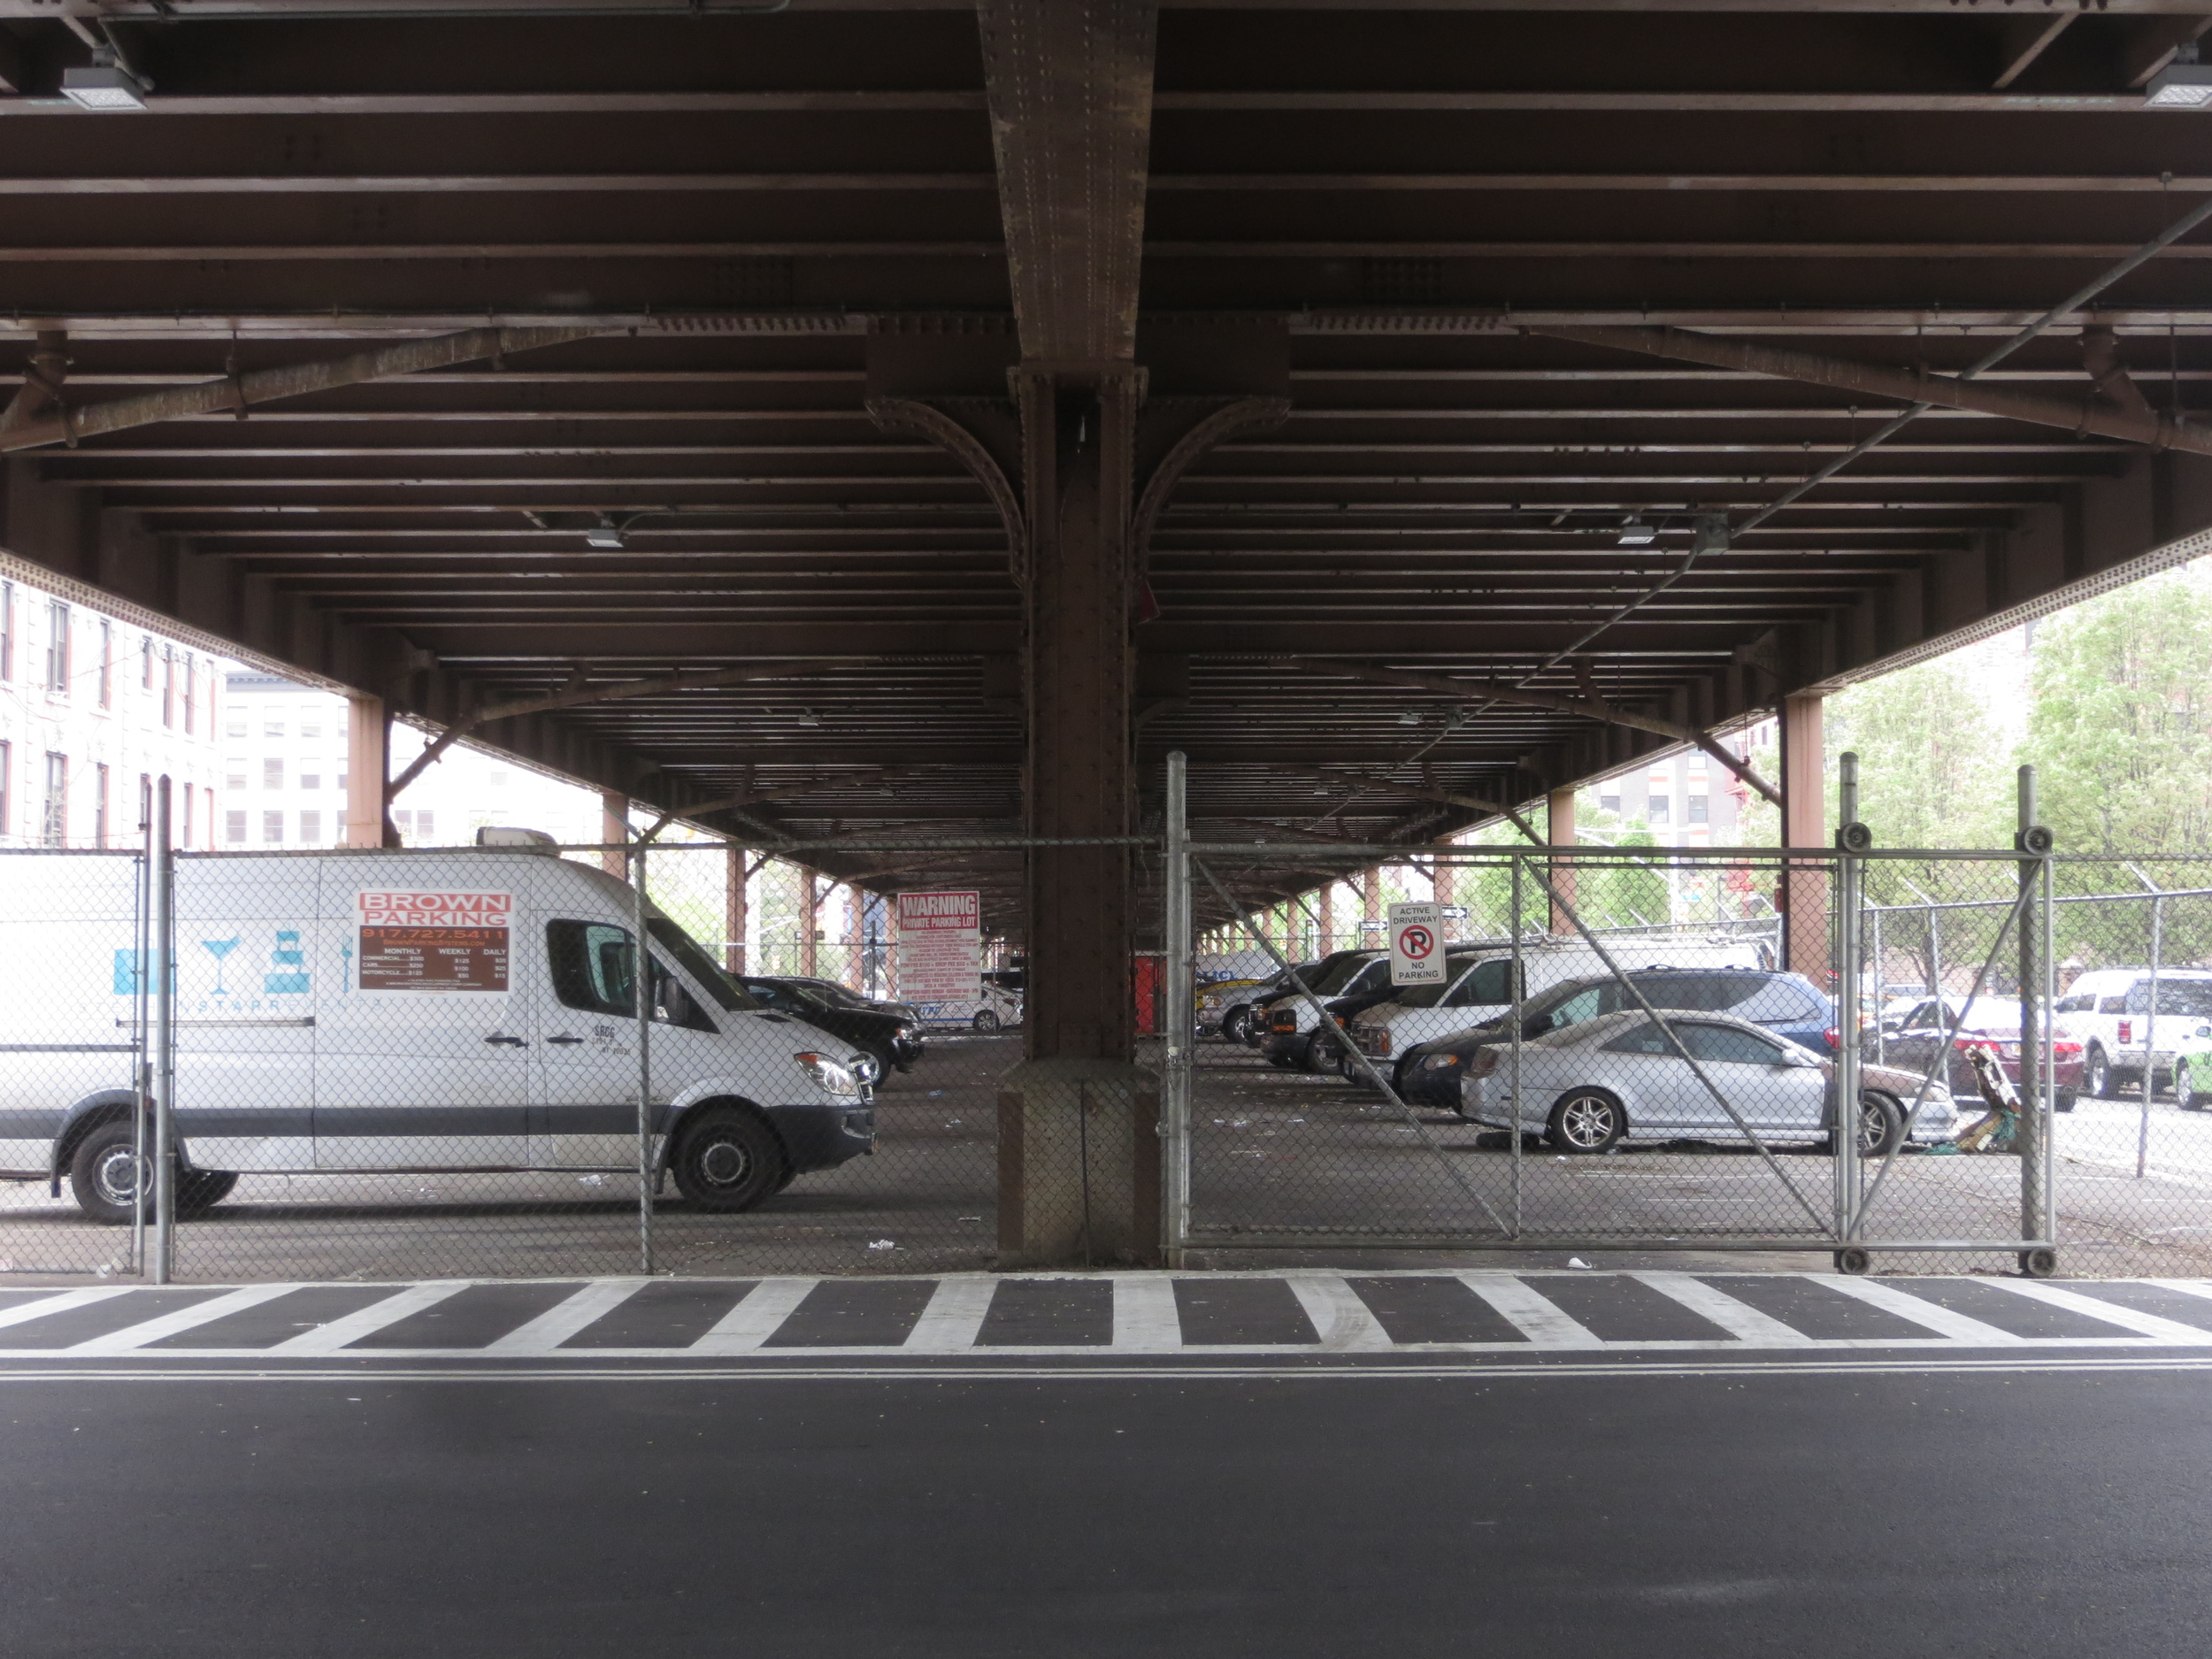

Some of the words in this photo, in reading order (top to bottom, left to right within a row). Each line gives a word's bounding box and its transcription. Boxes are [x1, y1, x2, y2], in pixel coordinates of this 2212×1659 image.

[365, 895, 507, 910] BROWN
[902, 895, 976, 917] WARNING
[365, 911, 507, 926] PARKING
[903, 918, 930, 929] PRIVATE
[931, 916, 961, 928] PARKING
[963, 916, 976, 927] LOT
[1393, 915, 1438, 925] DRIVEWAY
[363, 929, 504, 939] 917.727.5411
[1411, 961, 1425, 970] NO
[1398, 970, 1439, 979] PARKING
